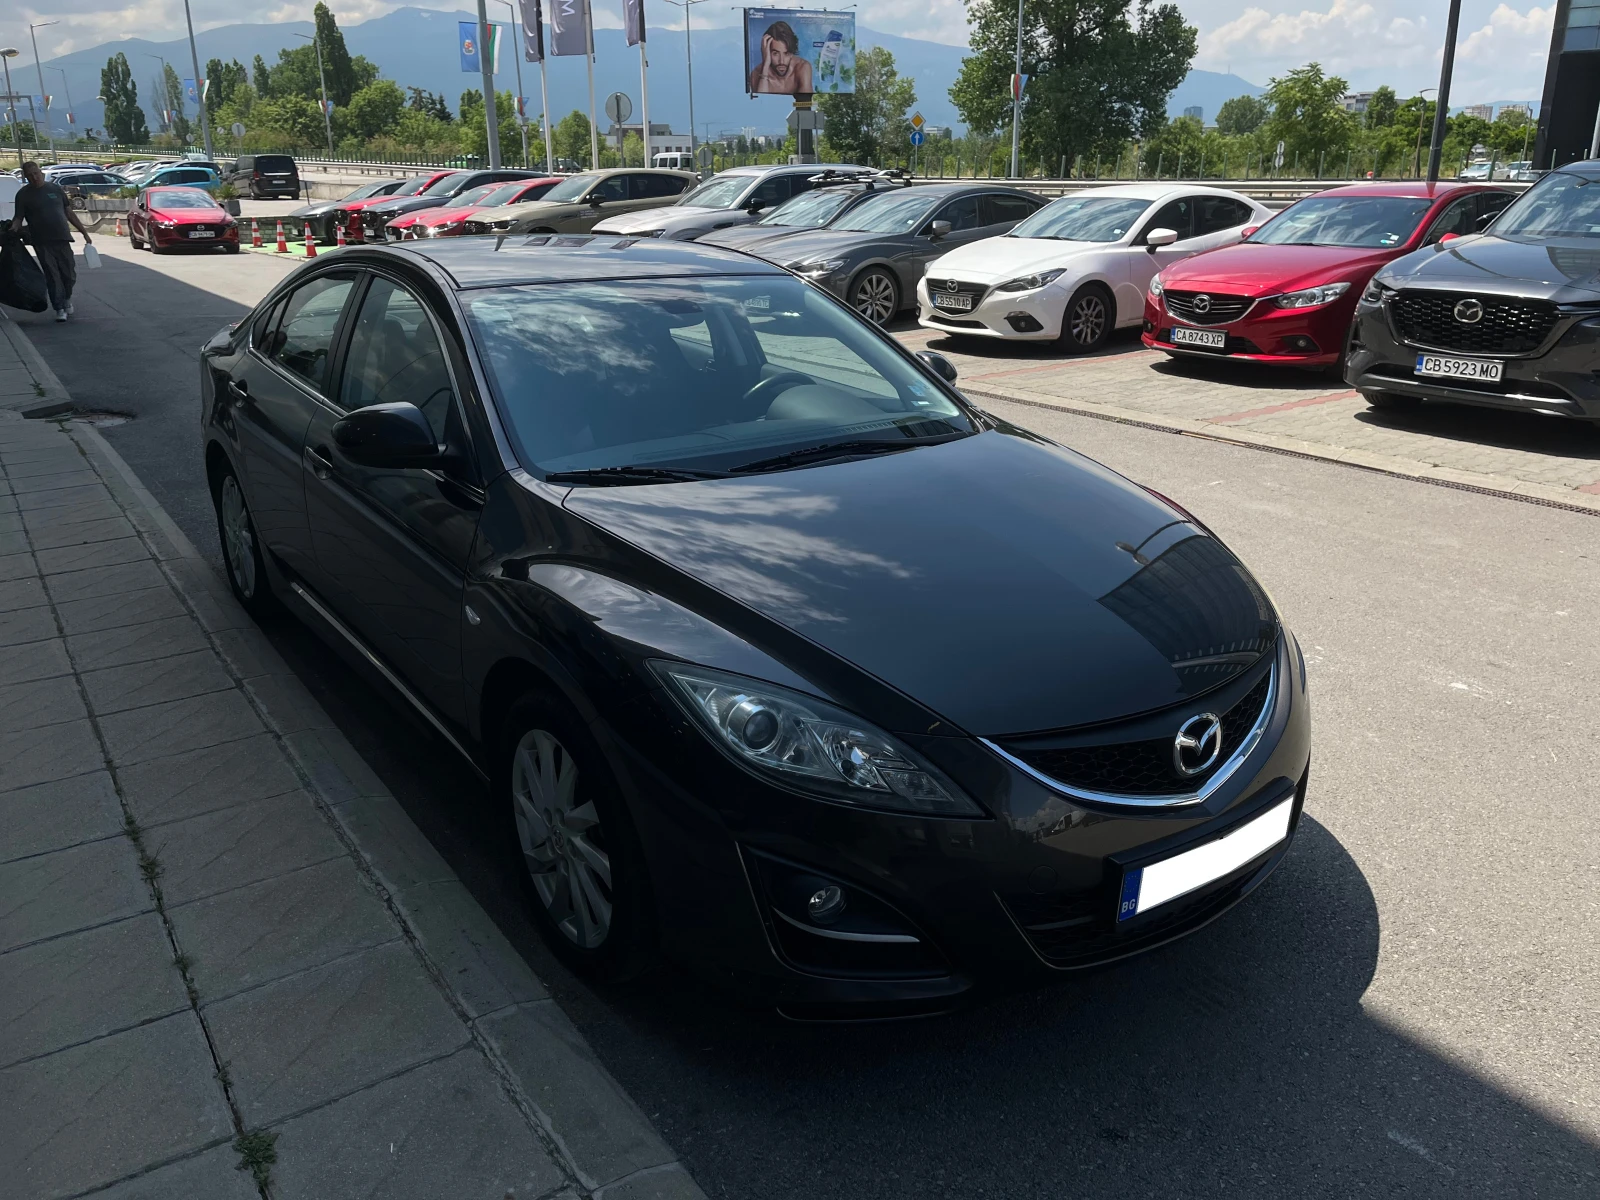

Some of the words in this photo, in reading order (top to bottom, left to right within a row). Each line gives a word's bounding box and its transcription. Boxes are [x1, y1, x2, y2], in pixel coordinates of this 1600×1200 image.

[945, 296, 961, 307] 5510
[961, 298, 971, 308] AP
[1176, 329, 1187, 341] CA
[1188, 331, 1210, 344] 8743
[1210, 333, 1223, 346] XP
[1424, 358, 1442, 372] CB
[1443, 360, 1477, 376] 5923
[1479, 363, 1499, 378] MO
[1121, 898, 1136, 913] BG
